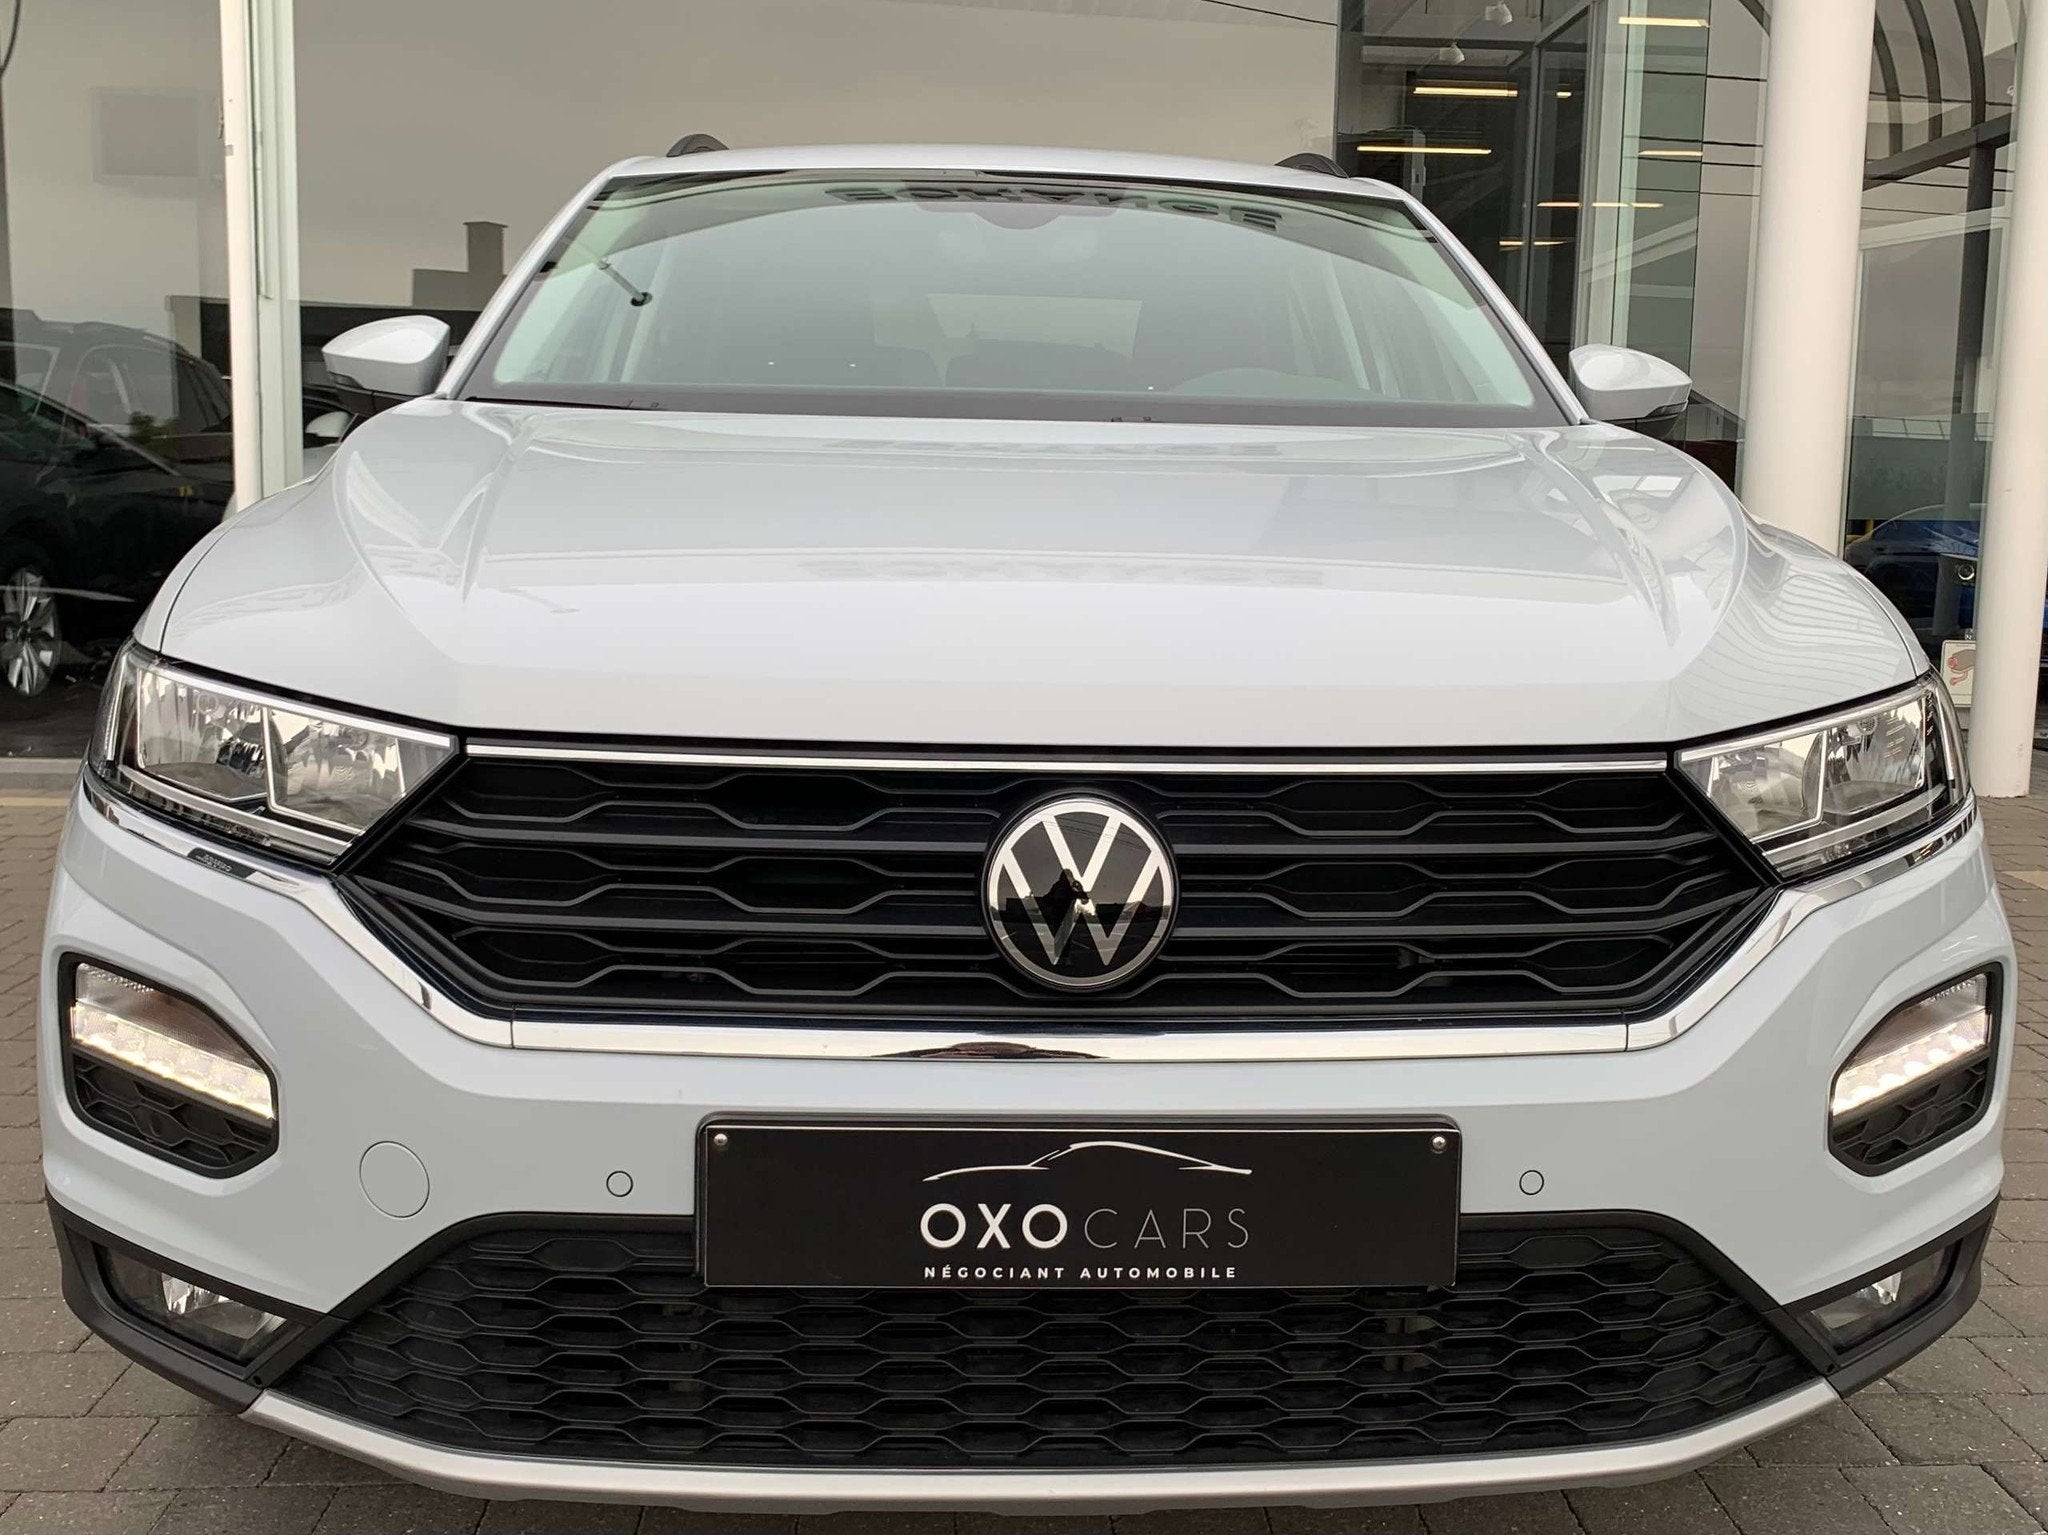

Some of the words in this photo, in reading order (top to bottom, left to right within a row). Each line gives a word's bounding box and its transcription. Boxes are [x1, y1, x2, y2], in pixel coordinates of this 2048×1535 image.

[920, 1203, 1068, 1249] OXO
[1084, 1208, 1249, 1249] CARS
[924, 1264, 1065, 1279] NÉGOCIANT
[1079, 1266, 1237, 1279] AUTOMOBILE
